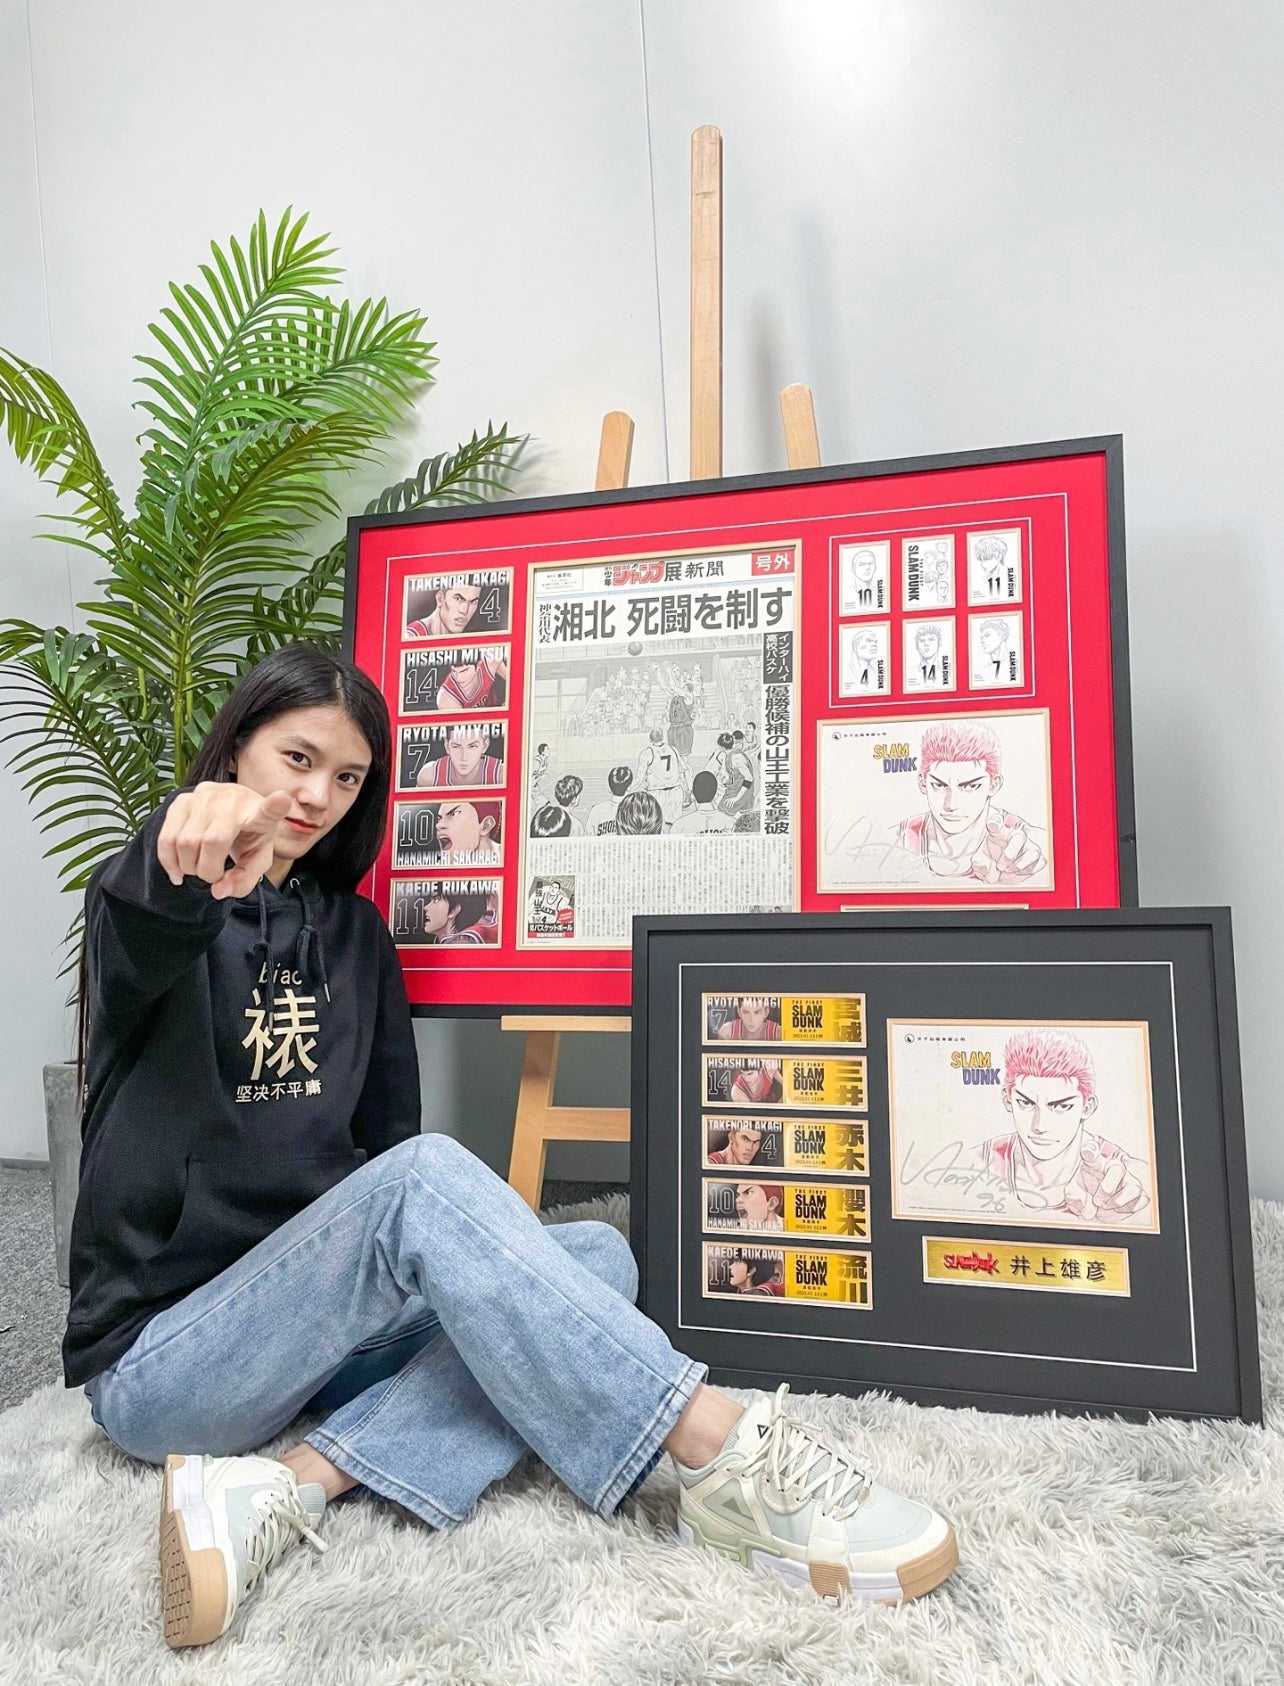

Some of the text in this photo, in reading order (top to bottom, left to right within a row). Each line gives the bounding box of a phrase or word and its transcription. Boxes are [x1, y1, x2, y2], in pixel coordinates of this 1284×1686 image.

[756, 553, 790, 571] 号外
[908, 545, 919, 601] SLAM DUNK
[410, 574, 469, 592] TAKENORI
[988, 577, 1000, 597] 11
[480, 587, 501, 623] 4
[858, 588, 872, 607] 10
[553, 587, 792, 642] 湘北 死闘を制す
[407, 650, 457, 667] HISASHI
[765, 634, 778, 675] 高校バスケ
[778, 633, 790, 681] インターハイ
[860, 669, 869, 687] 4
[921, 665, 936, 684] 14
[992, 660, 1001, 679] 7
[405, 668, 439, 703] 14
[403, 727, 447, 743] RYOTA
[873, 743, 909, 760] SLAM
[407, 743, 431, 780] 7
[660, 755, 671, 772] 7
[883, 757, 917, 773] DUNK
[400, 809, 435, 847] 10
[397, 851, 450, 867] HANAMICHI
[396, 880, 500, 897] KAEDE RUKAWA
[396, 898, 425, 935] 11
[708, 997, 780, 1009] RYOTA MIYAGI
[792, 1005, 823, 1016] SLAM
[711, 1009, 728, 1034] 7
[792, 1016, 823, 1028] DUNK
[708, 1057, 745, 1069] HISASHI
[950, 1051, 992, 1069] SLAM
[709, 1069, 733, 1095] 14
[793, 1067, 824, 1079] SLAM
[962, 1068, 1001, 1085] DUNK
[235, 1079, 322, 1103] 坚决不平庸
[793, 1079, 824, 1091] DUNK
[709, 1119, 782, 1132] TAKENORI AKAGI
[794, 1130, 826, 1142] SLAM
[760, 1133, 777, 1160] 4
[794, 1142, 826, 1154] DUNK
[836, 1125, 865, 1171] 赤木
[709, 1186, 735, 1214] 10
[795, 1194, 827, 1207] SLAM
[795, 1206, 827, 1219] DUNK
[708, 1246, 784, 1262] KAEDE RUKAWA
[709, 1259, 730, 1286] 11
[796, 1260, 828, 1273] SLAM
[1010, 1255, 1106, 1282] 井上雄彦
[796, 1272, 828, 1286] DUNK
